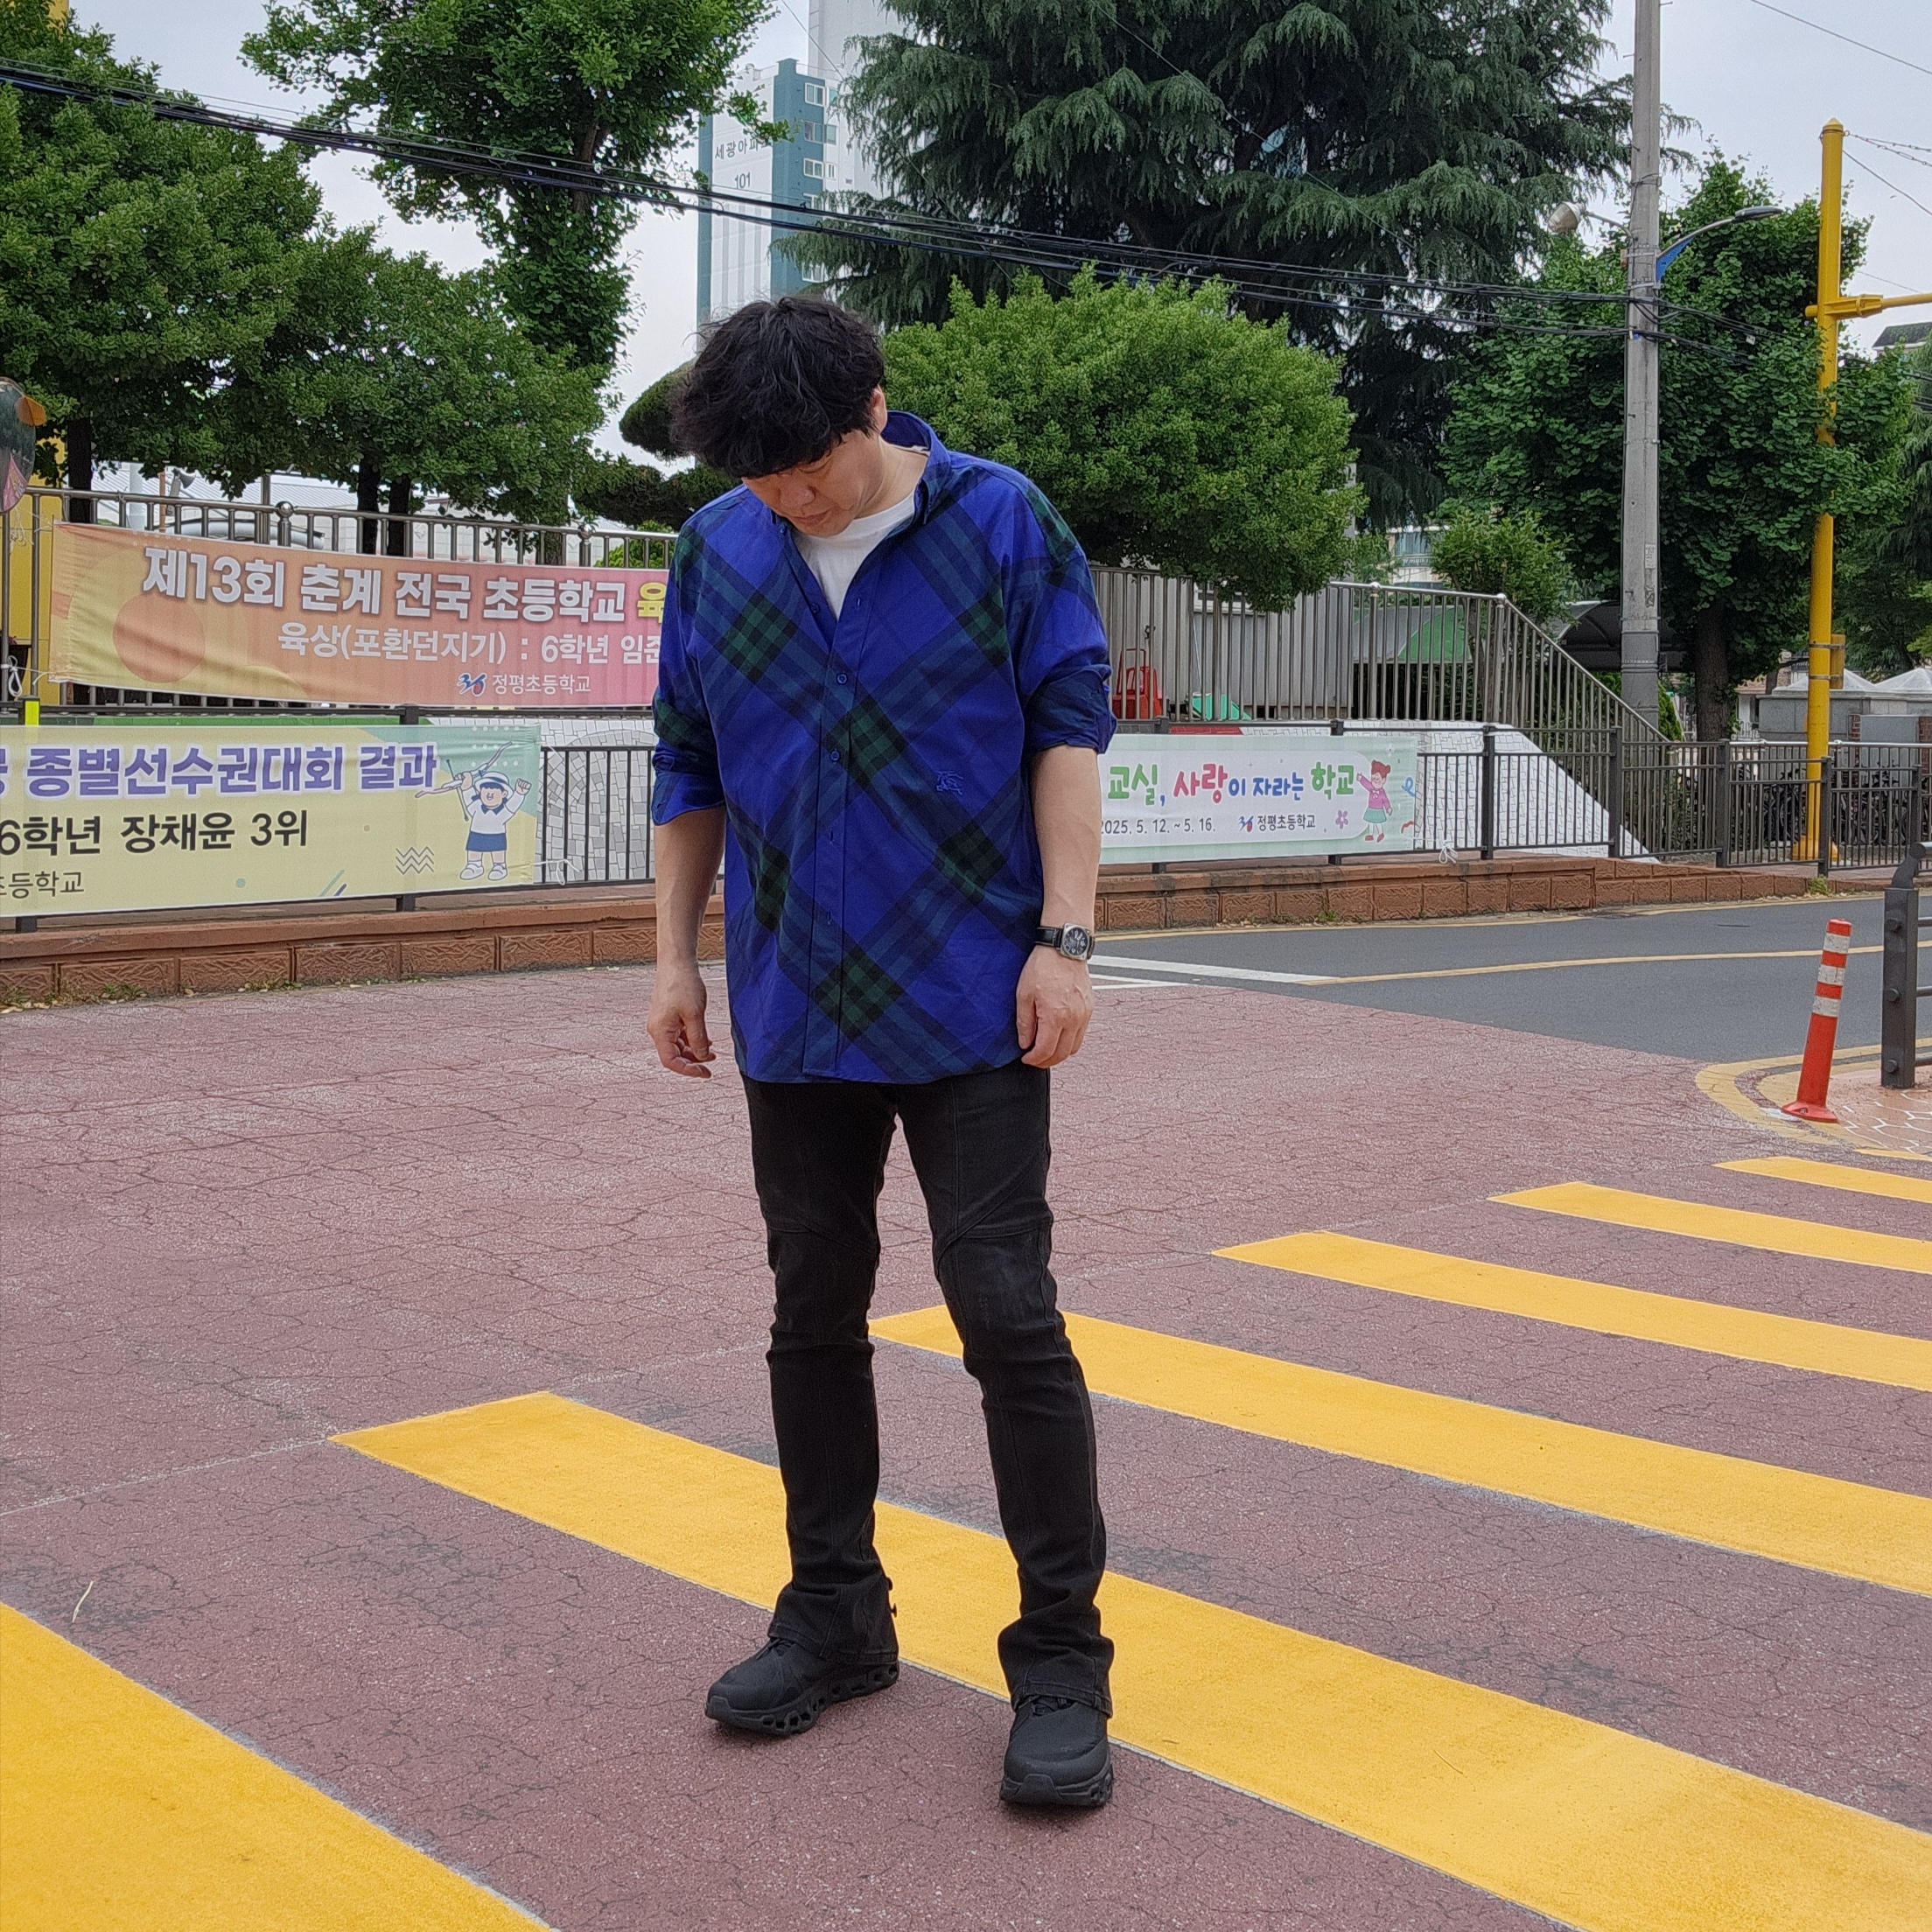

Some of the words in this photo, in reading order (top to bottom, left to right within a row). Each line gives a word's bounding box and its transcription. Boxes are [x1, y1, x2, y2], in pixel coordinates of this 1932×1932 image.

[715, 138, 773, 160] 세광아파
[734, 172, 750, 189] 101
[143, 547, 284, 607] 제13회
[301, 564, 381, 613] 춘계
[396, 571, 471, 619] 전국
[483, 577, 625, 623] 초등학교
[278, 621, 506, 664] 육상(포환던지기)
[541, 634, 608, 664] 6학년
[492, 674, 591, 695] 정평초등학교
[27, 746, 343, 797] 종별선수권대회
[360, 746, 437, 790] 결과
[1108, 764, 1165, 806] 교실,
[1173, 763, 1246, 803] 사랑이
[1253, 772, 1304, 801] 자라는
[1311, 761, 1354, 801] 학교
[0, 815, 101, 856] 6학년
[121, 812, 235, 853] 장채윤
[250, 809, 307, 846] 3위
[1257, 814, 1315, 831] 정평초등학교
